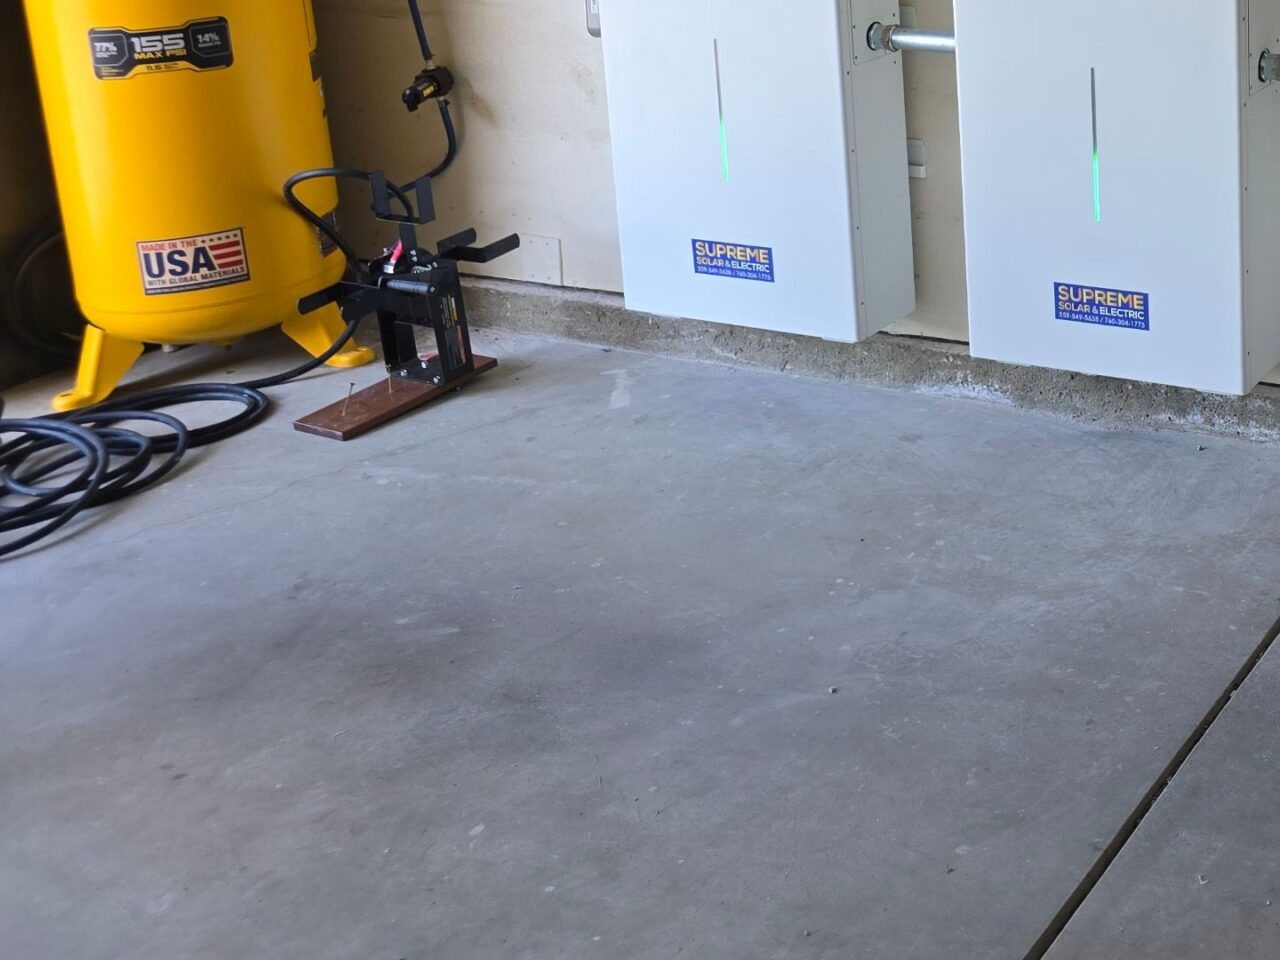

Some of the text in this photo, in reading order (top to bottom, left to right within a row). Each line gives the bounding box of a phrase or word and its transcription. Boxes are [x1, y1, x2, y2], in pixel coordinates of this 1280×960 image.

[131, 33, 184, 52] 155
[133, 48, 187, 59] MAX PSI
[141, 243, 166, 251] MADE
[180, 239, 197, 247] THE
[695, 241, 769, 263] SUPREME
[143, 246, 216, 279] USA
[696, 256, 769, 272] SOLAR & ELECTRIC
[169, 276, 198, 285] GLOBAL
[200, 266, 245, 280] MATERIALS
[1058, 285, 1144, 310] SUPREME
[1058, 301, 1145, 320] SOLAR & ELECTRIC
